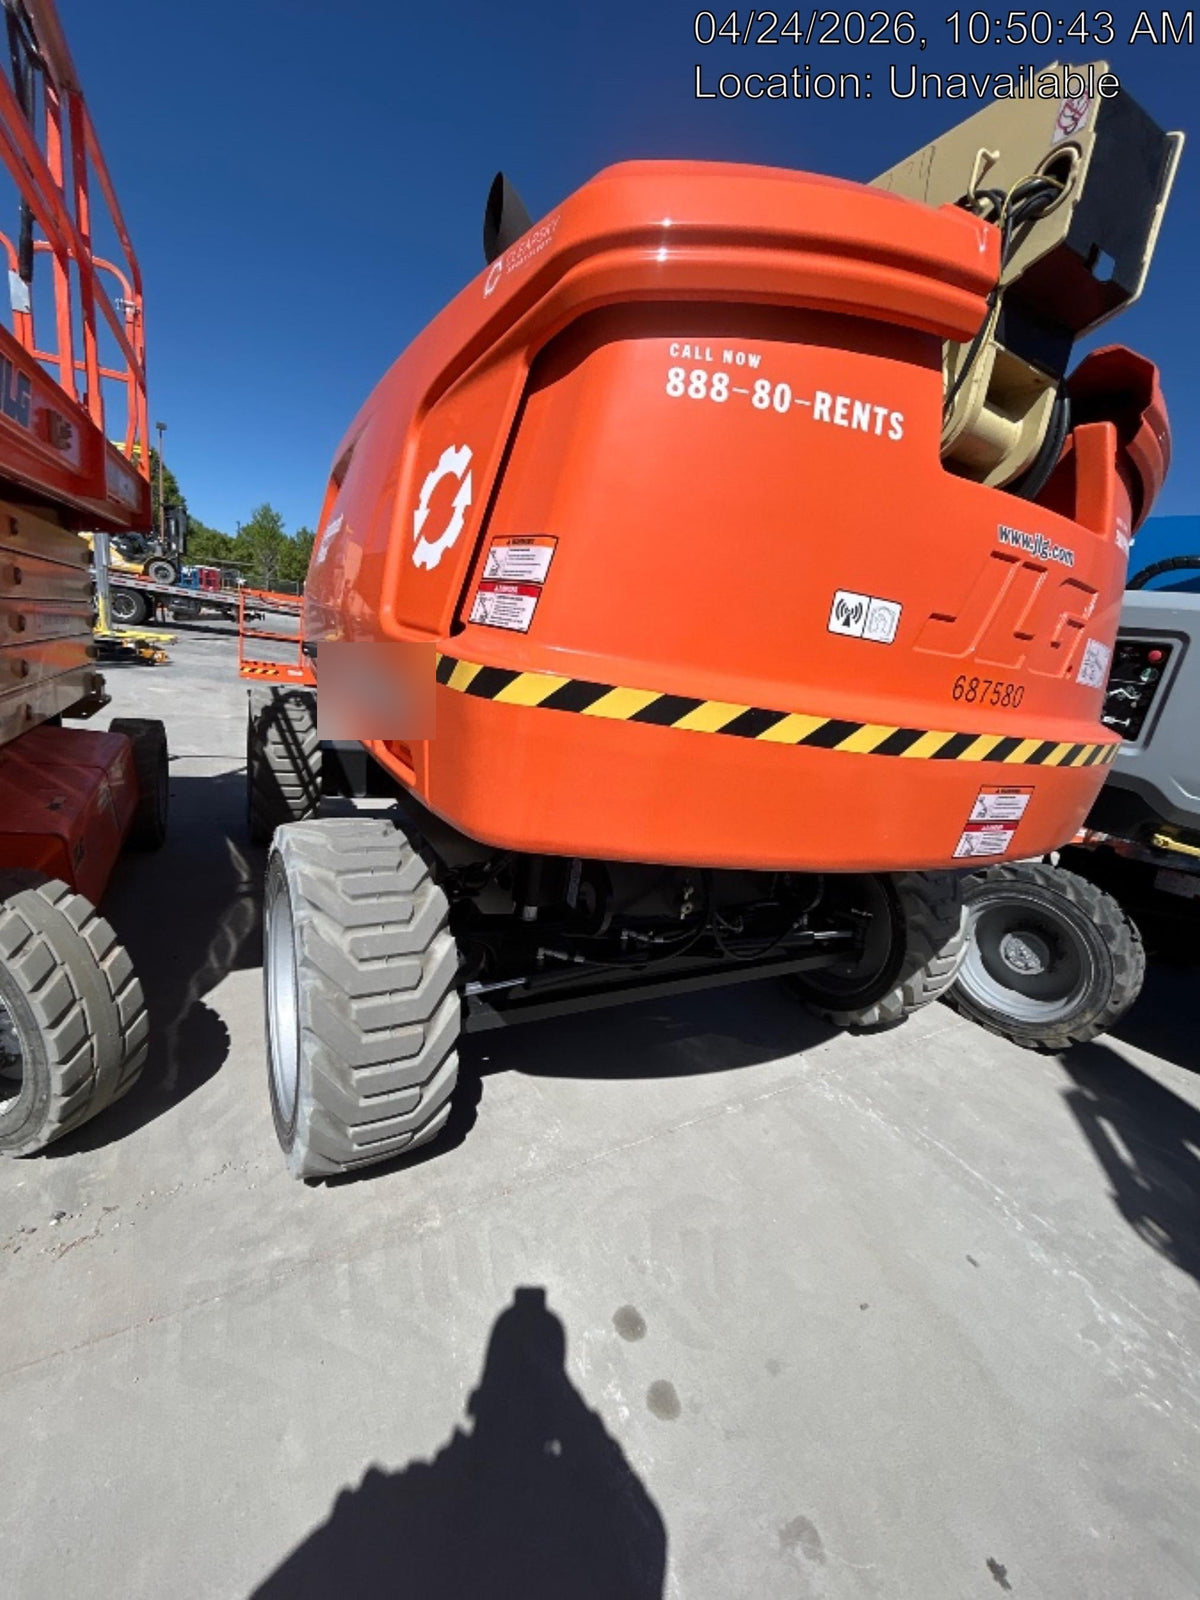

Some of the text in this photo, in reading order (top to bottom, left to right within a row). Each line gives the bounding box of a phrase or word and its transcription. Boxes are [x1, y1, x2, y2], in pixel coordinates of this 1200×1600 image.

[669, 342, 762, 369] CALL NOW
[665, 366, 905, 441] 888-80-RENTS
[997, 524, 1075, 567] www.jlg.com
[952, 674, 1025, 709] 687580
